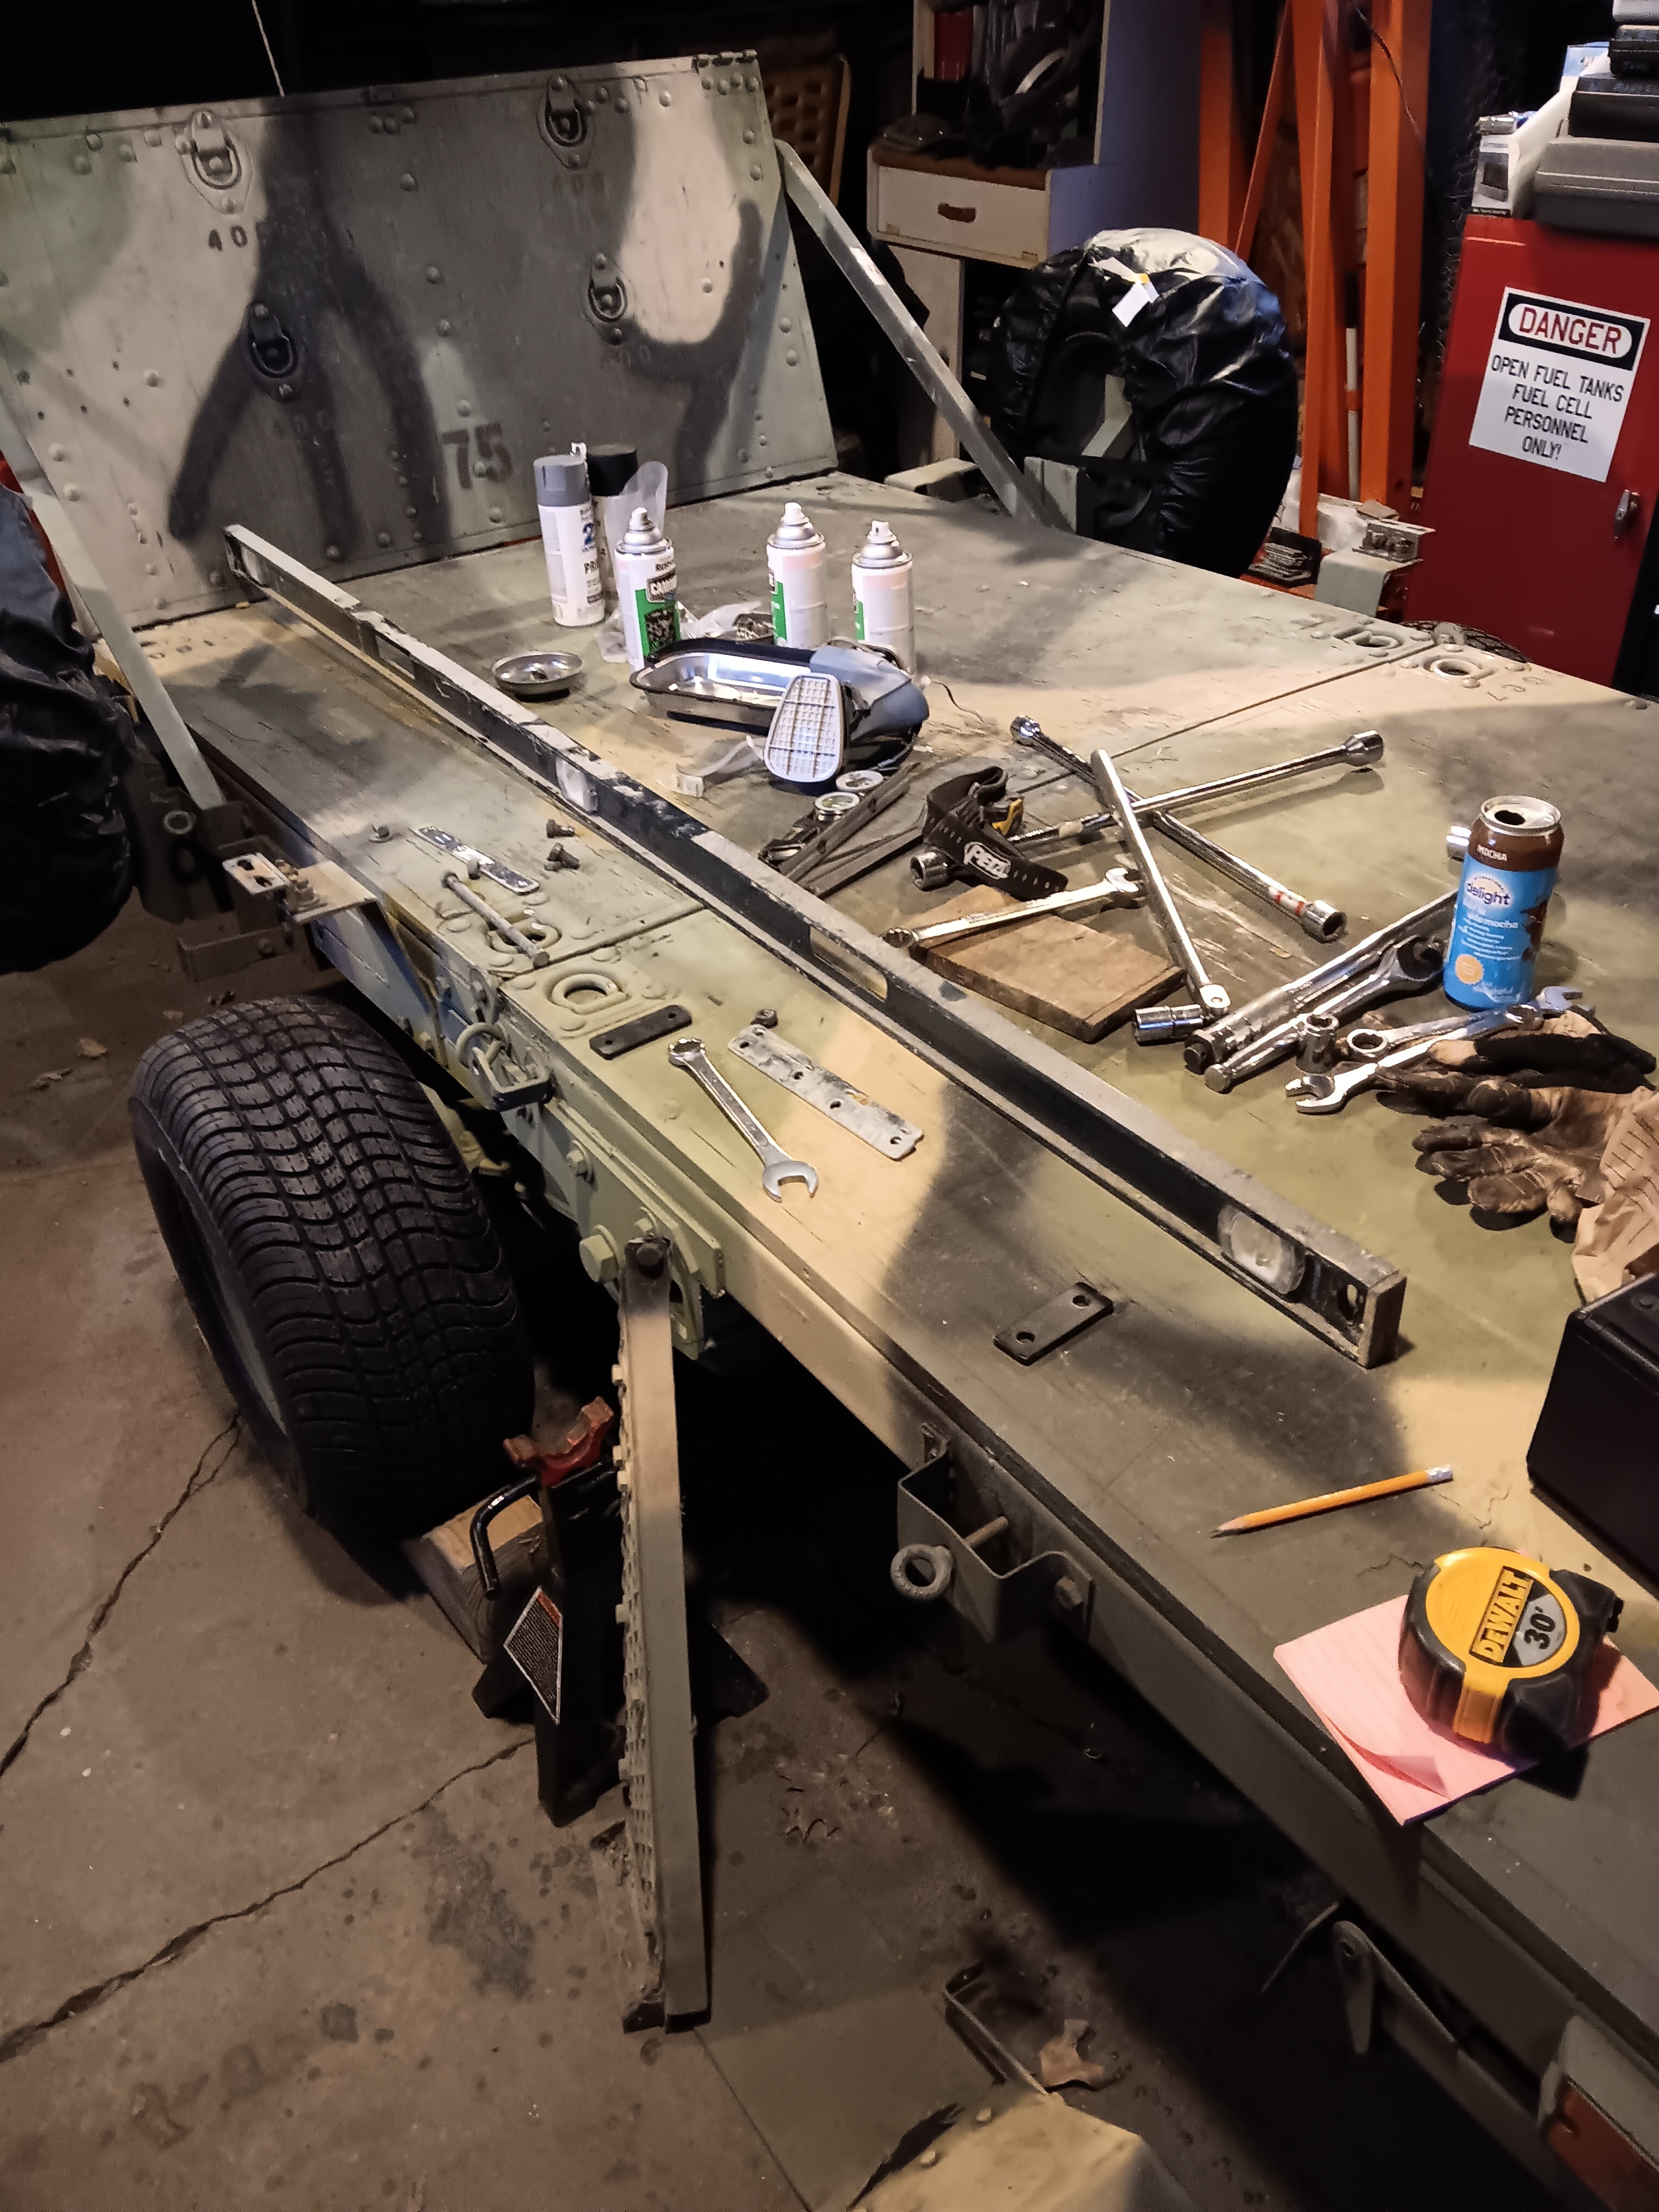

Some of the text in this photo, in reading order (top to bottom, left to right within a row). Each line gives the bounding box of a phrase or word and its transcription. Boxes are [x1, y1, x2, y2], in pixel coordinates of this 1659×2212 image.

[1519, 307, 1622, 355] DANGER
[1491, 355, 1625, 402] OPEN FUEL TANKS
[1512, 383, 1593, 419] FUEL CELL
[1503, 406, 1589, 443] PERSONNEL
[441, 422, 514, 490] 75
[1521, 436, 1562, 460] ONLY!
[1476, 844, 1508, 862] MOCHA
[1465, 882, 1512, 905] delight
[1474, 1568, 1533, 1663] DEWALT
